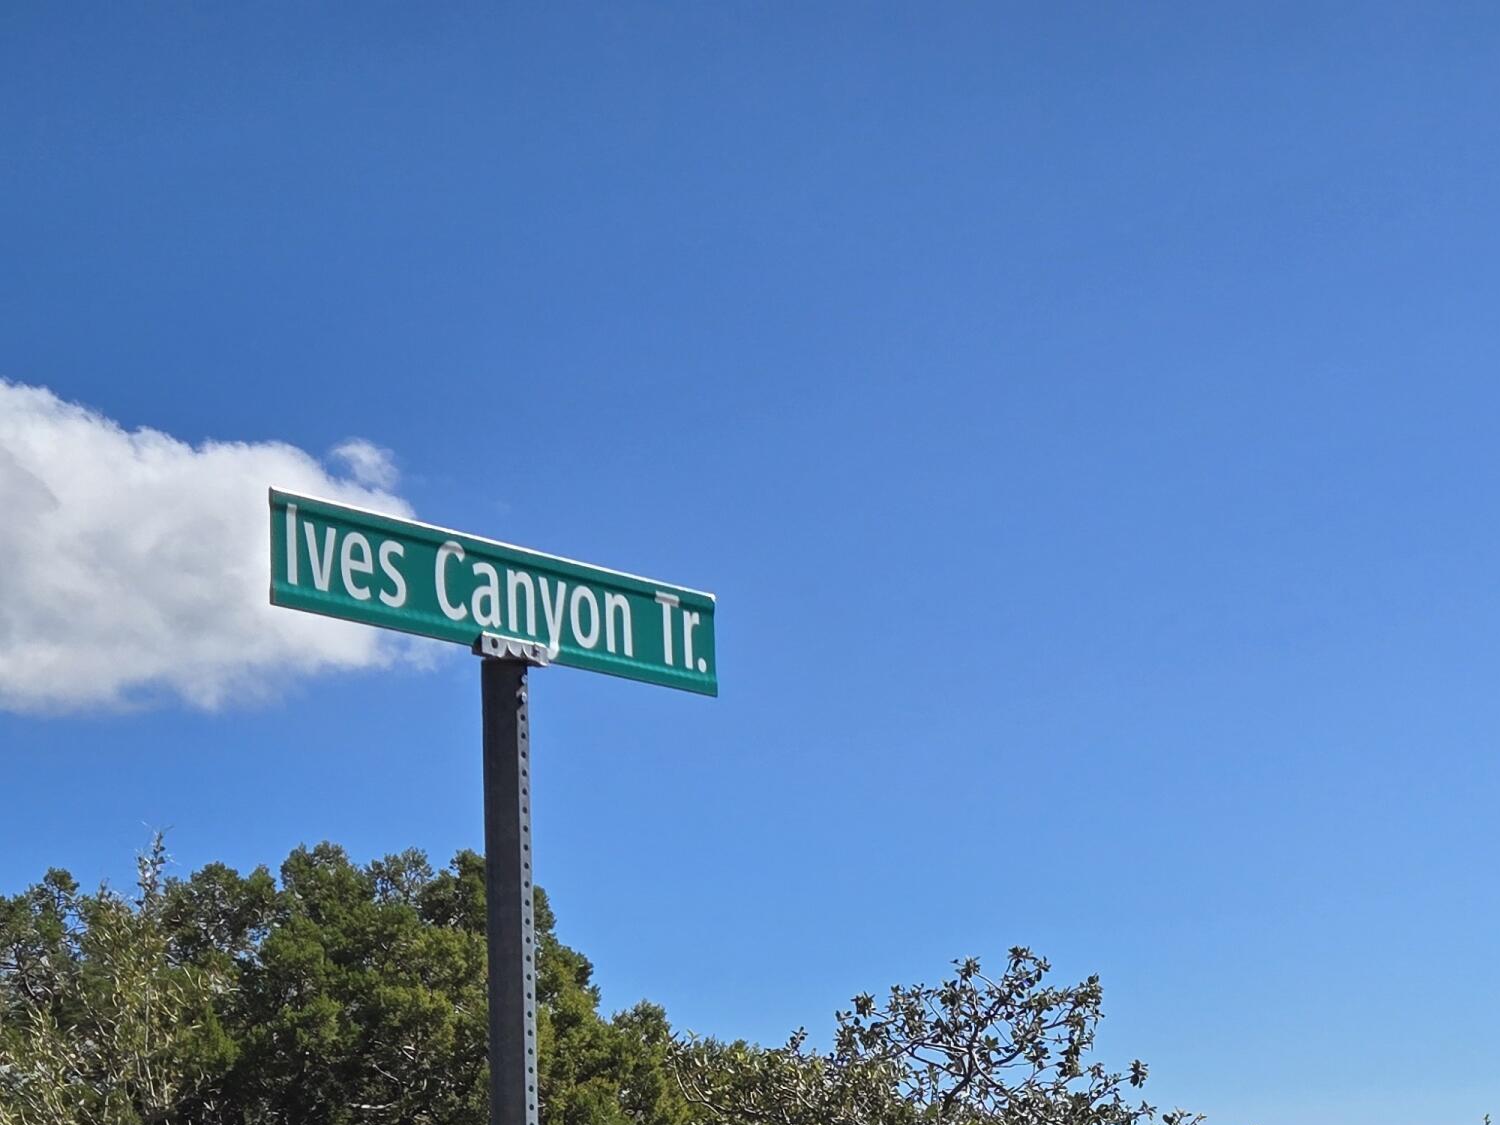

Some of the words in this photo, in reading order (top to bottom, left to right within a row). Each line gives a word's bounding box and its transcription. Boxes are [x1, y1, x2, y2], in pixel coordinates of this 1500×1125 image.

[286, 503, 407, 607] Ives
[434, 540, 633, 659] Canyon
[655, 590, 707, 673] Tr.
